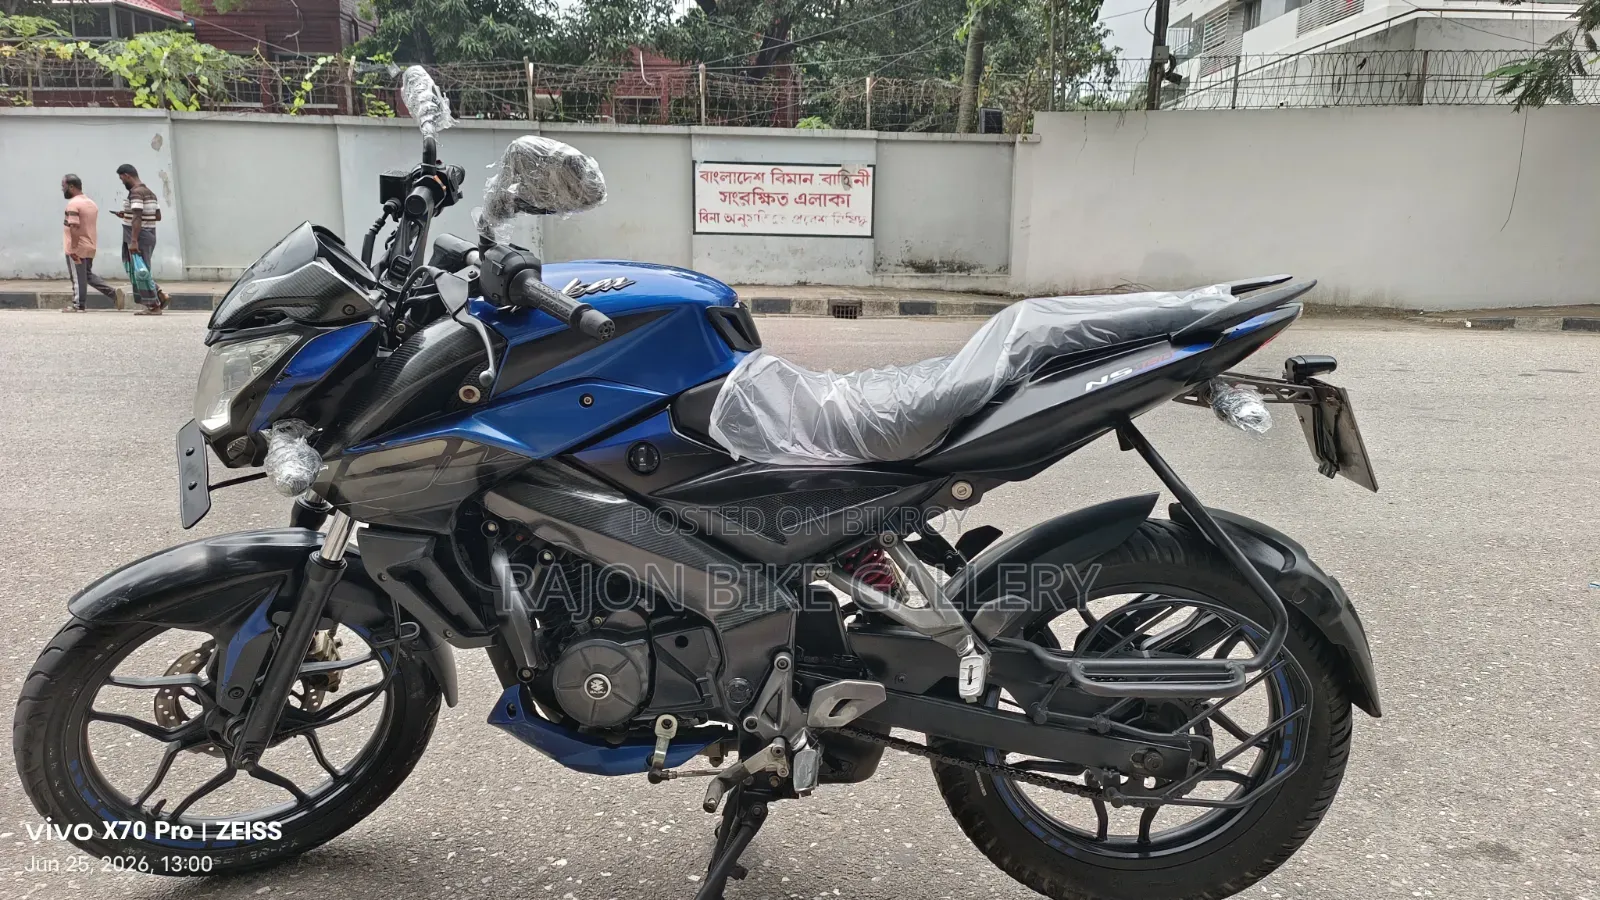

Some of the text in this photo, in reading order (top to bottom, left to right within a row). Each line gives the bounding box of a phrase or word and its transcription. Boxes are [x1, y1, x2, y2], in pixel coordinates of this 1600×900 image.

[699, 167, 871, 189] বাংলাদেশ বিমান বাহিনী
[719, 186, 851, 208] সংরক্ষিত এলাকা
[699, 208, 720, 224] বিনা
[1085, 367, 1132, 391] NS
